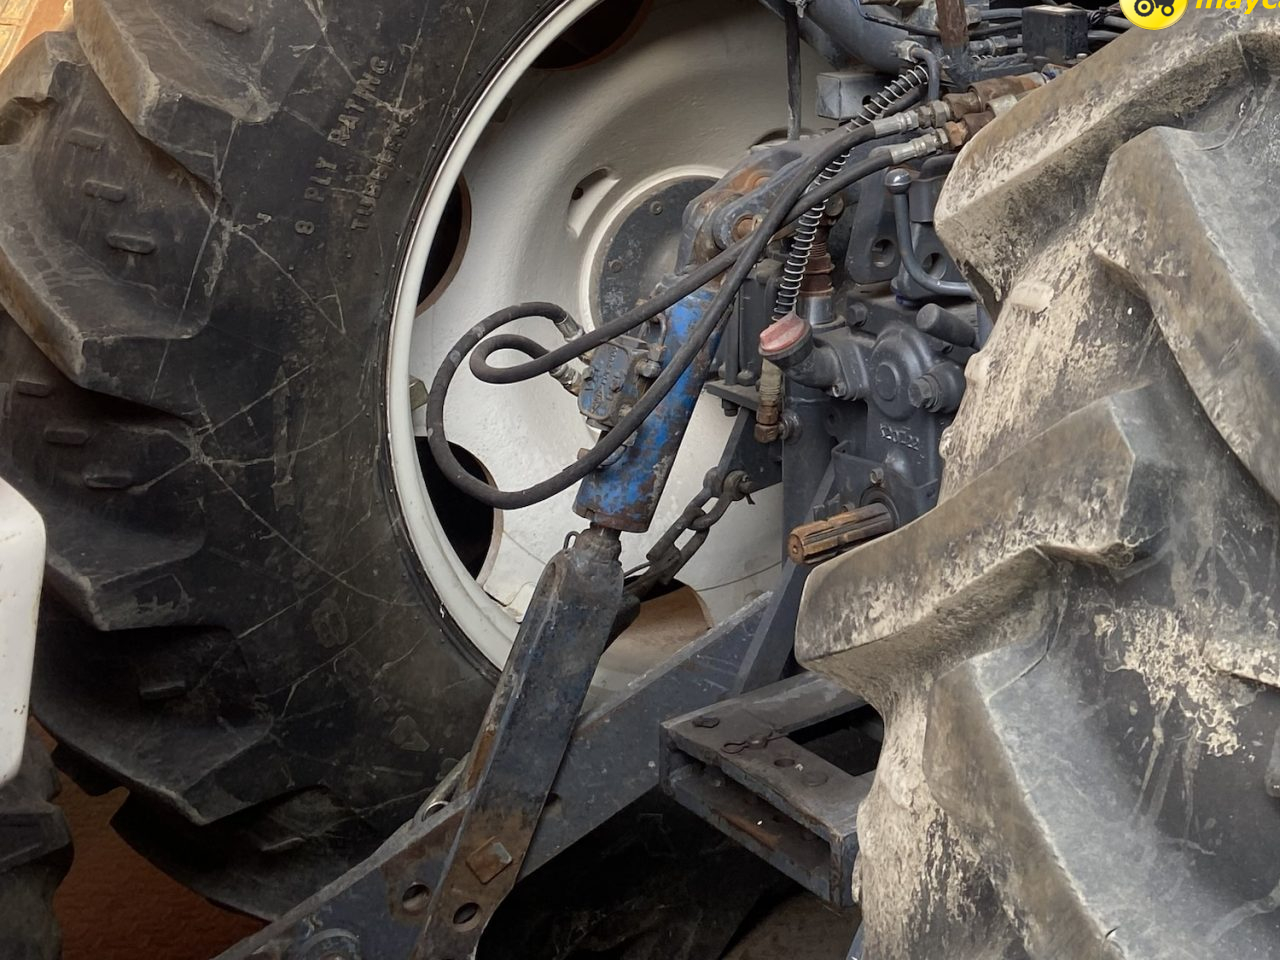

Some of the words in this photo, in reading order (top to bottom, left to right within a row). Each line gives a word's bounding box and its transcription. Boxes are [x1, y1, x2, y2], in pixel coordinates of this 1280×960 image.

[327, 56, 389, 147] RATING
[304, 156, 337, 201] PLY
[294, 219, 315, 235] 8
